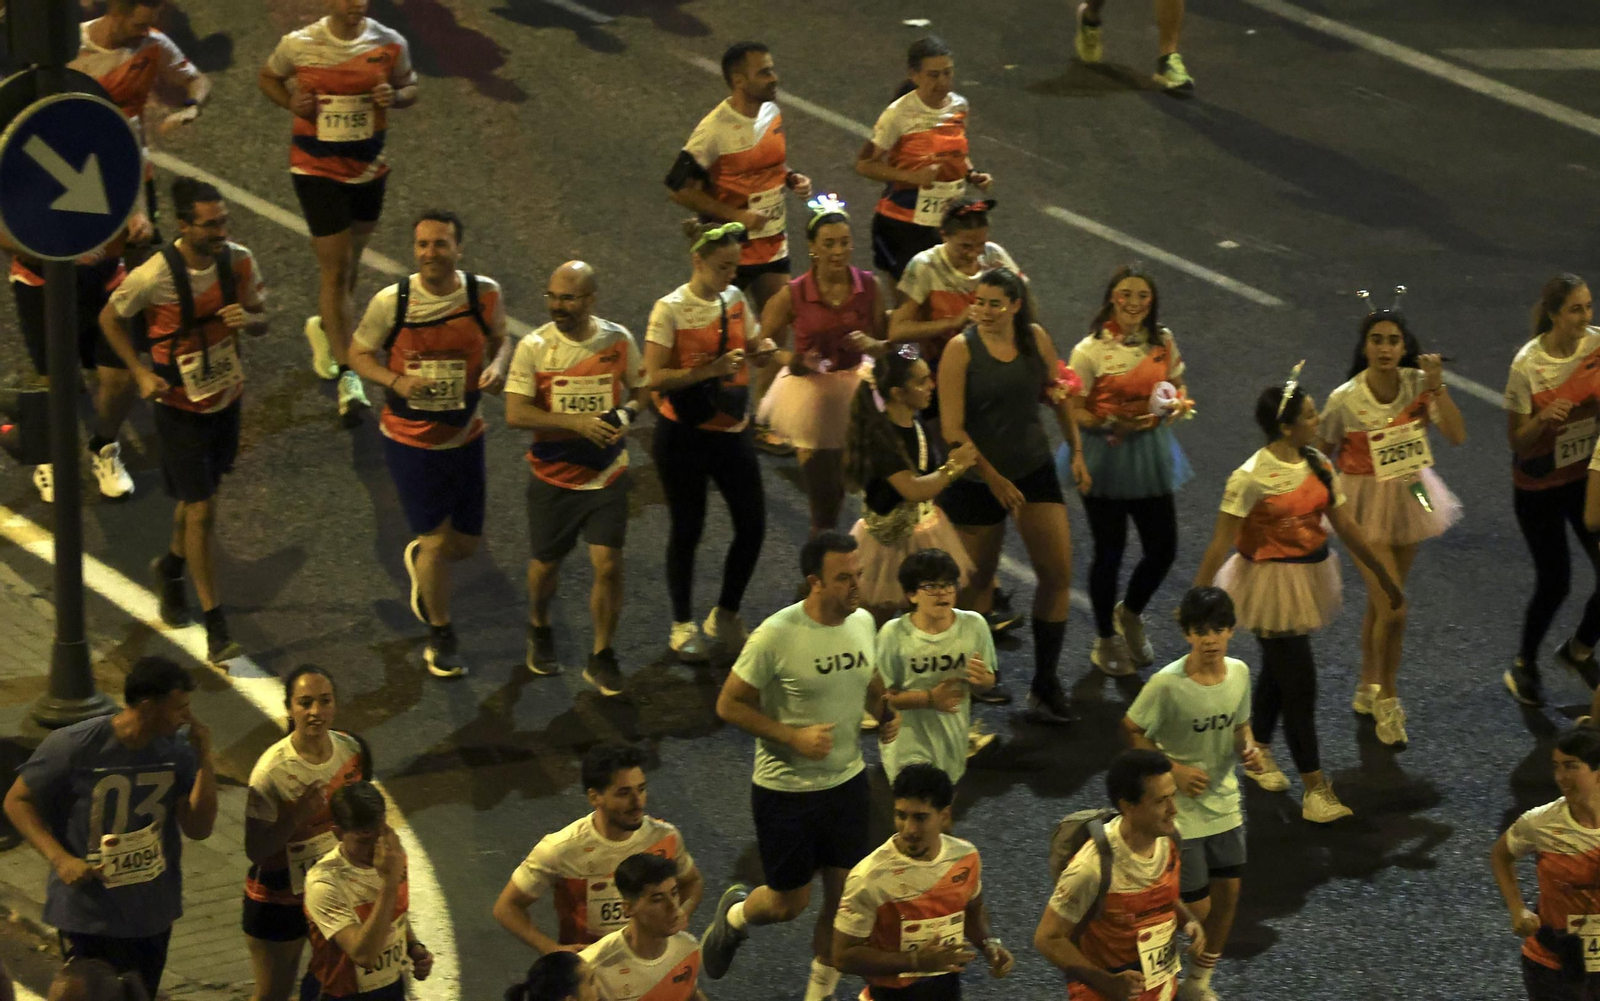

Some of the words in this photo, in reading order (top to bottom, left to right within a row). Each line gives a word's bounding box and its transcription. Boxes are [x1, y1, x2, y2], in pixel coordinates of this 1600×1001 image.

[559, 396, 605, 412] 14051
[1379, 440, 1424, 466] 22670
[88, 771, 175, 851] 03
